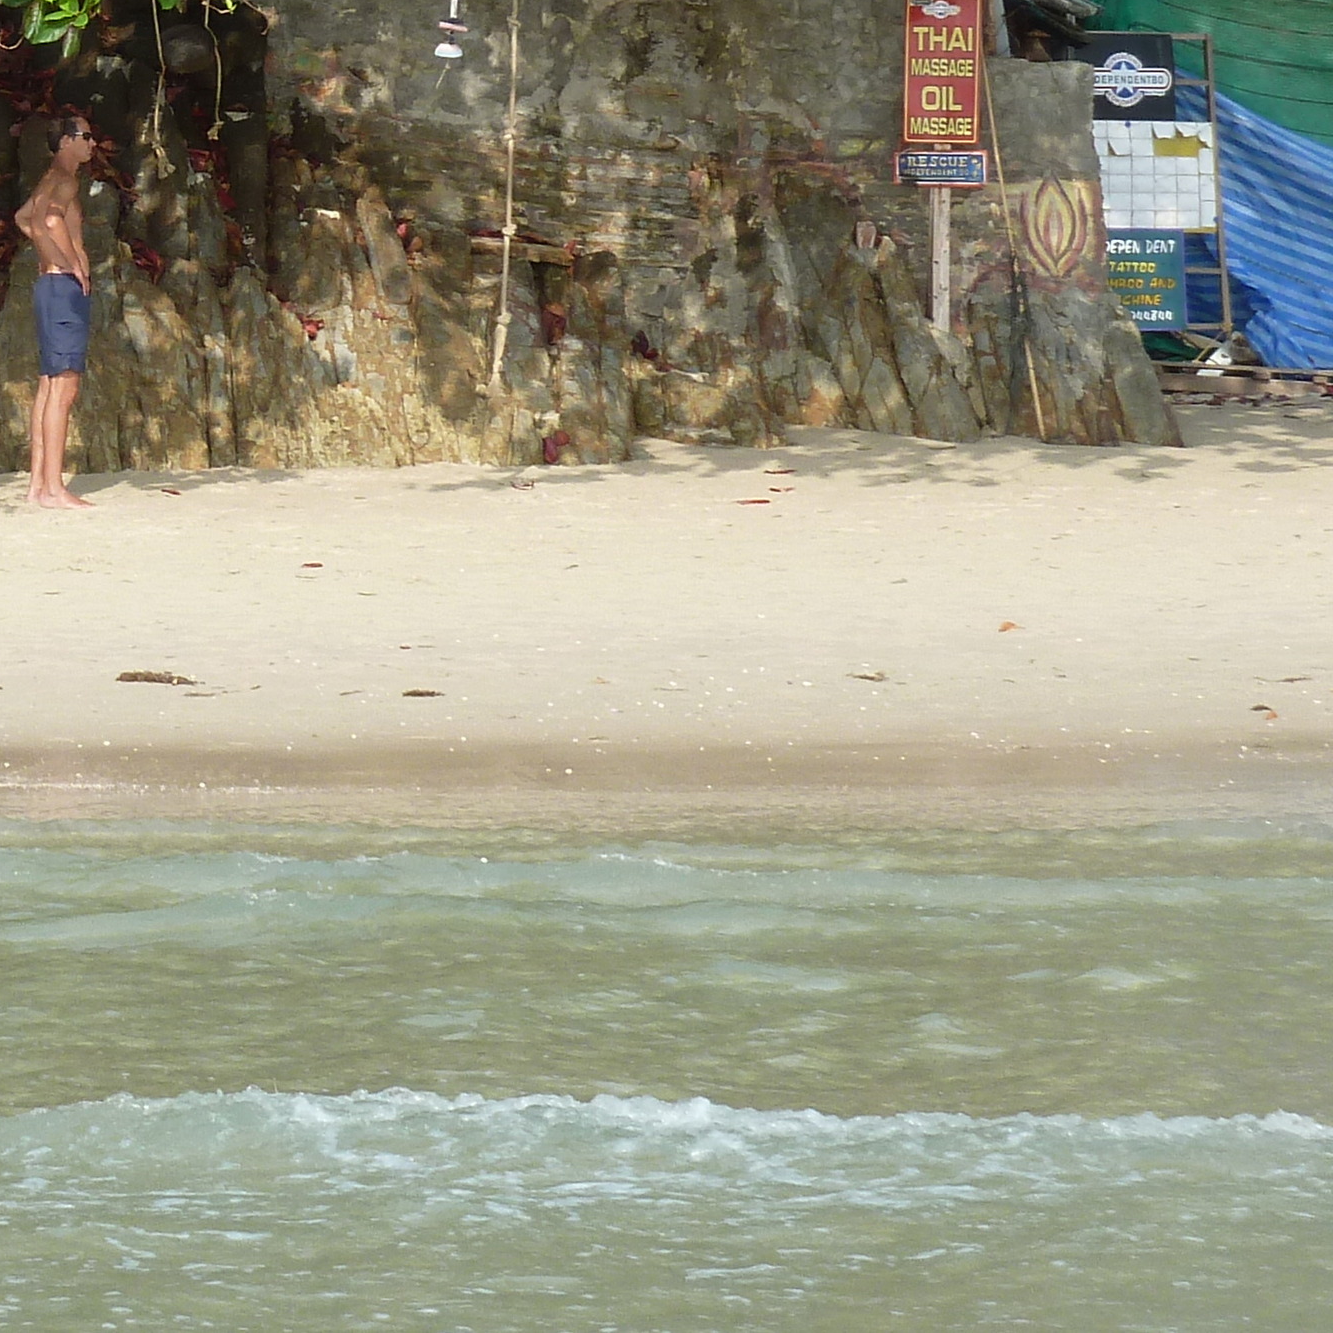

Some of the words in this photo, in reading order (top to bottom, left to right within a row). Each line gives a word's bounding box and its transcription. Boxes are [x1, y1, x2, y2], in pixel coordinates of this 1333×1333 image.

[913, 26, 974, 51] THAI
[911, 58, 974, 77] MASSAGE
[921, 85, 963, 111] OIL
[910, 117, 973, 136] MASSAGE
[906, 156, 968, 167] RESCUE
[1145, 239, 1176, 254] DENT
[1109, 261, 1156, 273] TATTOO
[1120, 294, 1162, 305] CHINE
